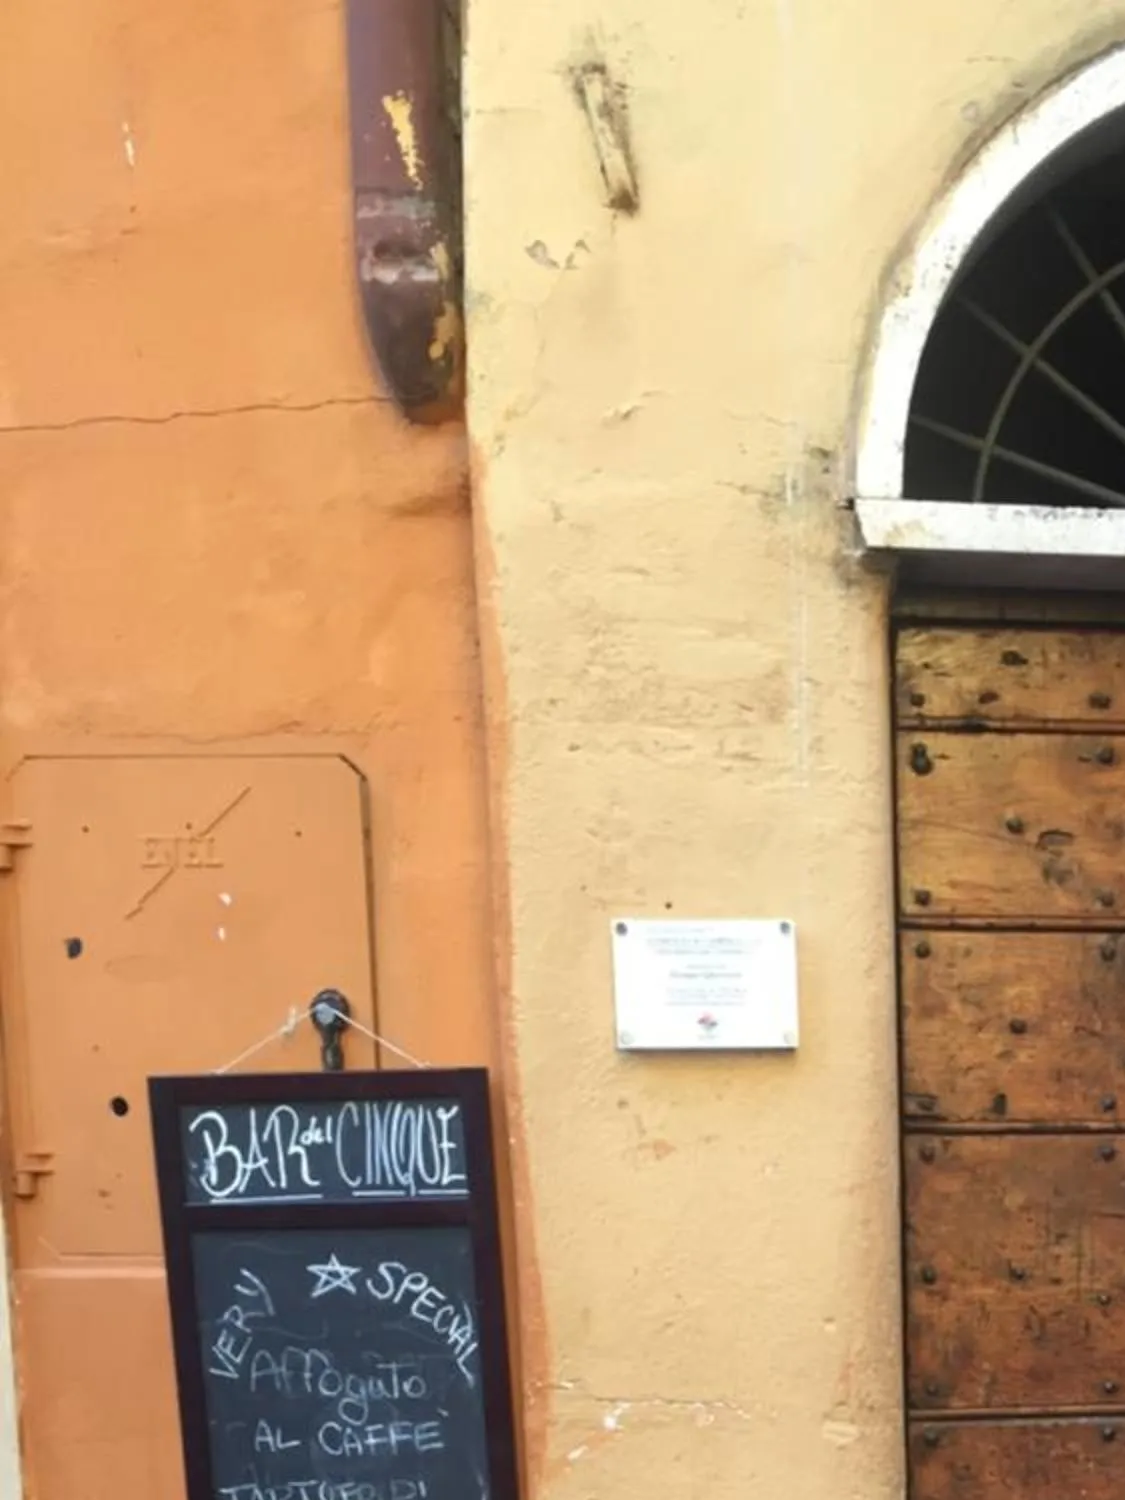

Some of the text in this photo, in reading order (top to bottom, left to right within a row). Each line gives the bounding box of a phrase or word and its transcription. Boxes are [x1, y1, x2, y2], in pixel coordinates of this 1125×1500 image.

[188, 1101, 468, 1196] BAR del CINQUE
[209, 1261, 479, 1389] VERY SPECIAL
[254, 1421, 301, 1453] AL
